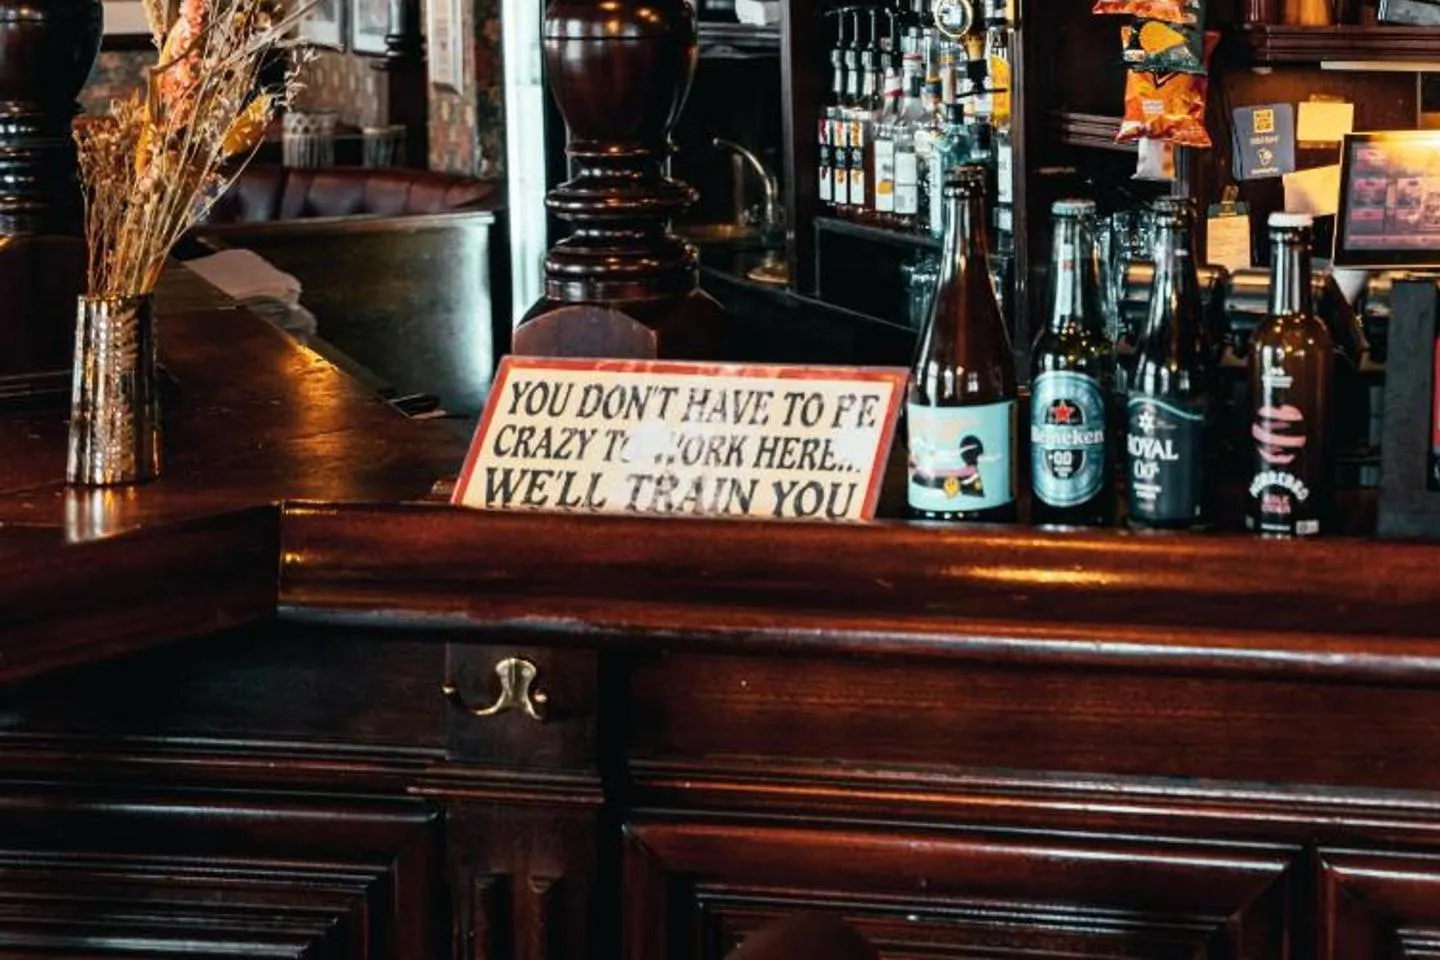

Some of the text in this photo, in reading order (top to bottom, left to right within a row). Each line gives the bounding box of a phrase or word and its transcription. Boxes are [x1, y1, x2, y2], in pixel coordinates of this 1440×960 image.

[507, 381, 575, 418] YOU
[575, 382, 679, 422] DON'T
[681, 387, 775, 426] HAVE
[782, 391, 825, 428] TO
[493, 424, 598, 461] CRAZY
[654, 431, 748, 467] ORK
[485, 467, 858, 519] WE'LL TRAIN YOU
